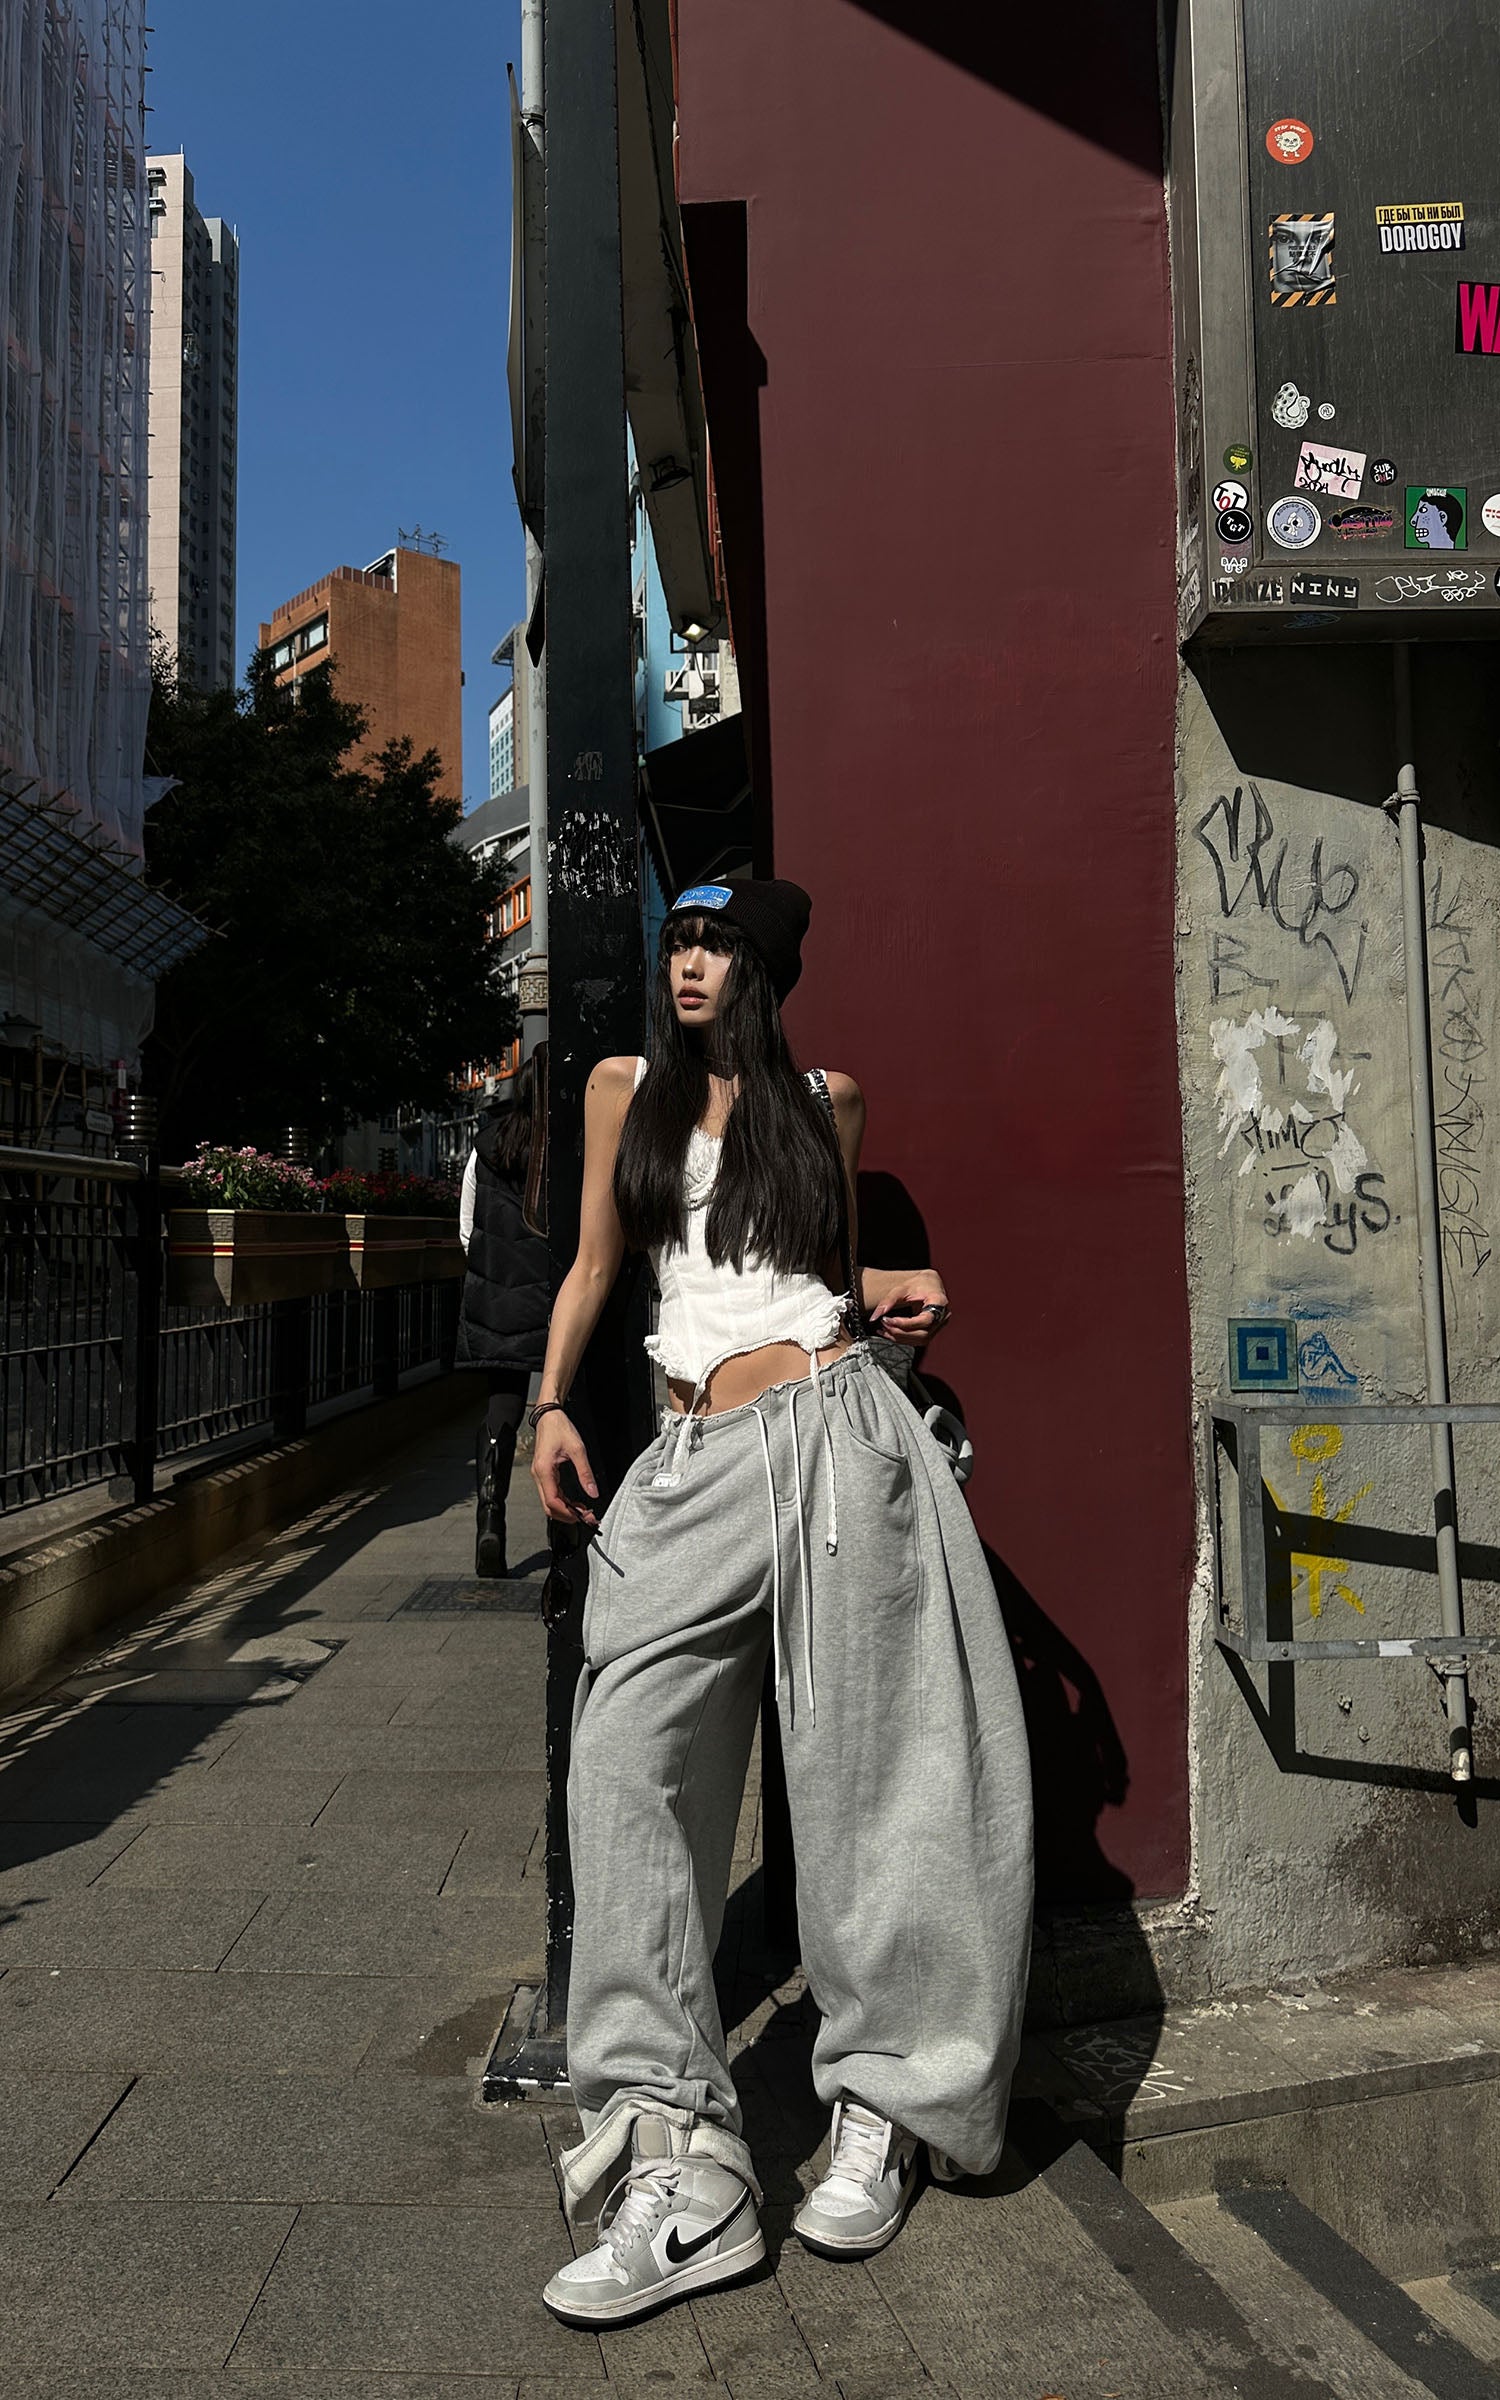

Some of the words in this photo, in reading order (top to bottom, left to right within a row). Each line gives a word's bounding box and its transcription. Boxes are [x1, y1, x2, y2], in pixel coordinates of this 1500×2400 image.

[1379, 209, 1395, 224] ГДЕ
[1396, 208, 1410, 221] БЫ
[1411, 207, 1425, 220] ТЫ
[1427, 206, 1439, 219] НИ
[1441, 205, 1460, 219] БЫЛ
[1380, 222, 1461, 252] DOROGOY
[1374, 463, 1391, 473] SUB
[1374, 469, 1394, 483] ONLY
[1226, 516, 1245, 532] TGT
